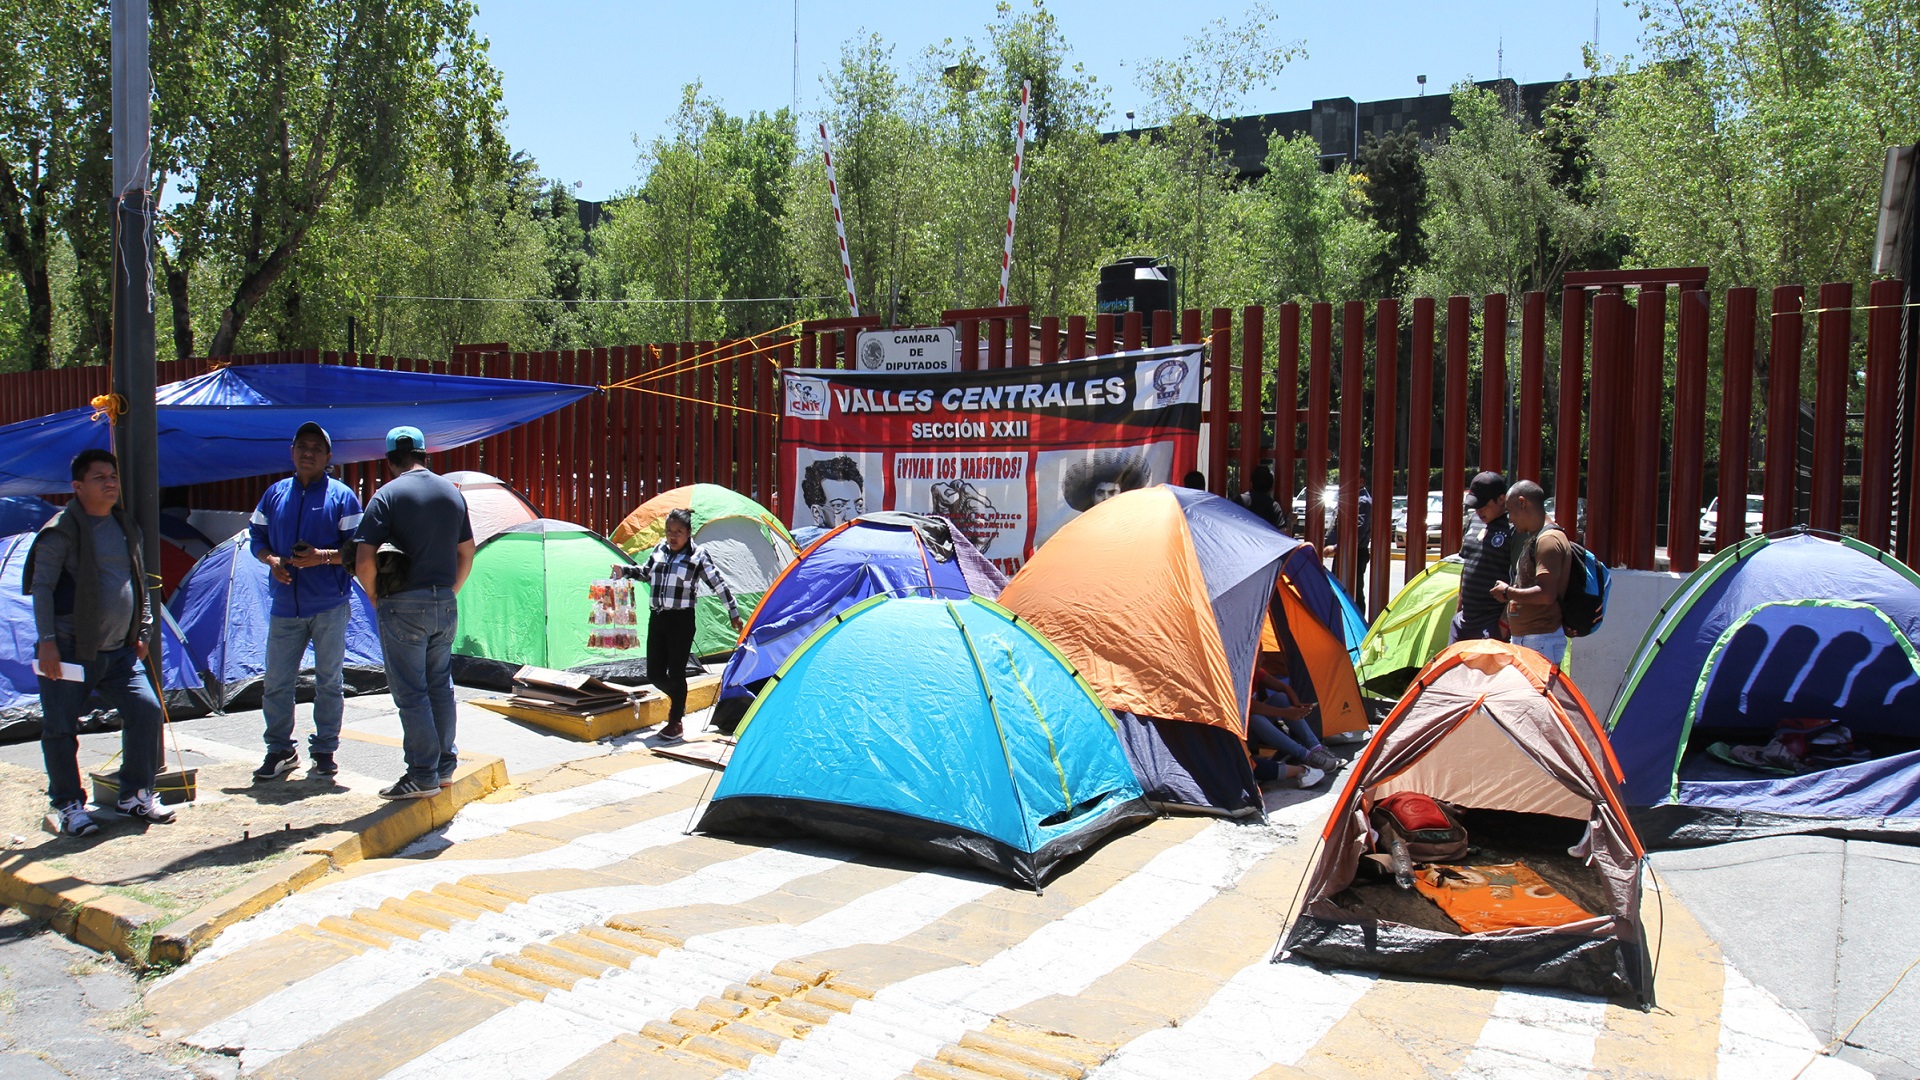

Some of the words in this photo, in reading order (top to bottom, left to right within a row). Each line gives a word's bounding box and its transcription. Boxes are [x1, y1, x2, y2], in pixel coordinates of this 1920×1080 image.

[894, 334, 940, 344] CAMARA
[909, 348, 924, 357] DE
[885, 360, 948, 371] DIPUTADOS
[833, 388, 935, 414] VALLES
[941, 376, 1127, 411] CENTRALES
[911, 418, 986, 439] SECCIÓN
[991, 421, 1029, 438] XXII
[897, 457, 934, 479] ¡VIVAN
[937, 457, 957, 479] LOS
[960, 456, 1023, 479] MAESTROS!
[988, 512, 1022, 520] MÉXICO
